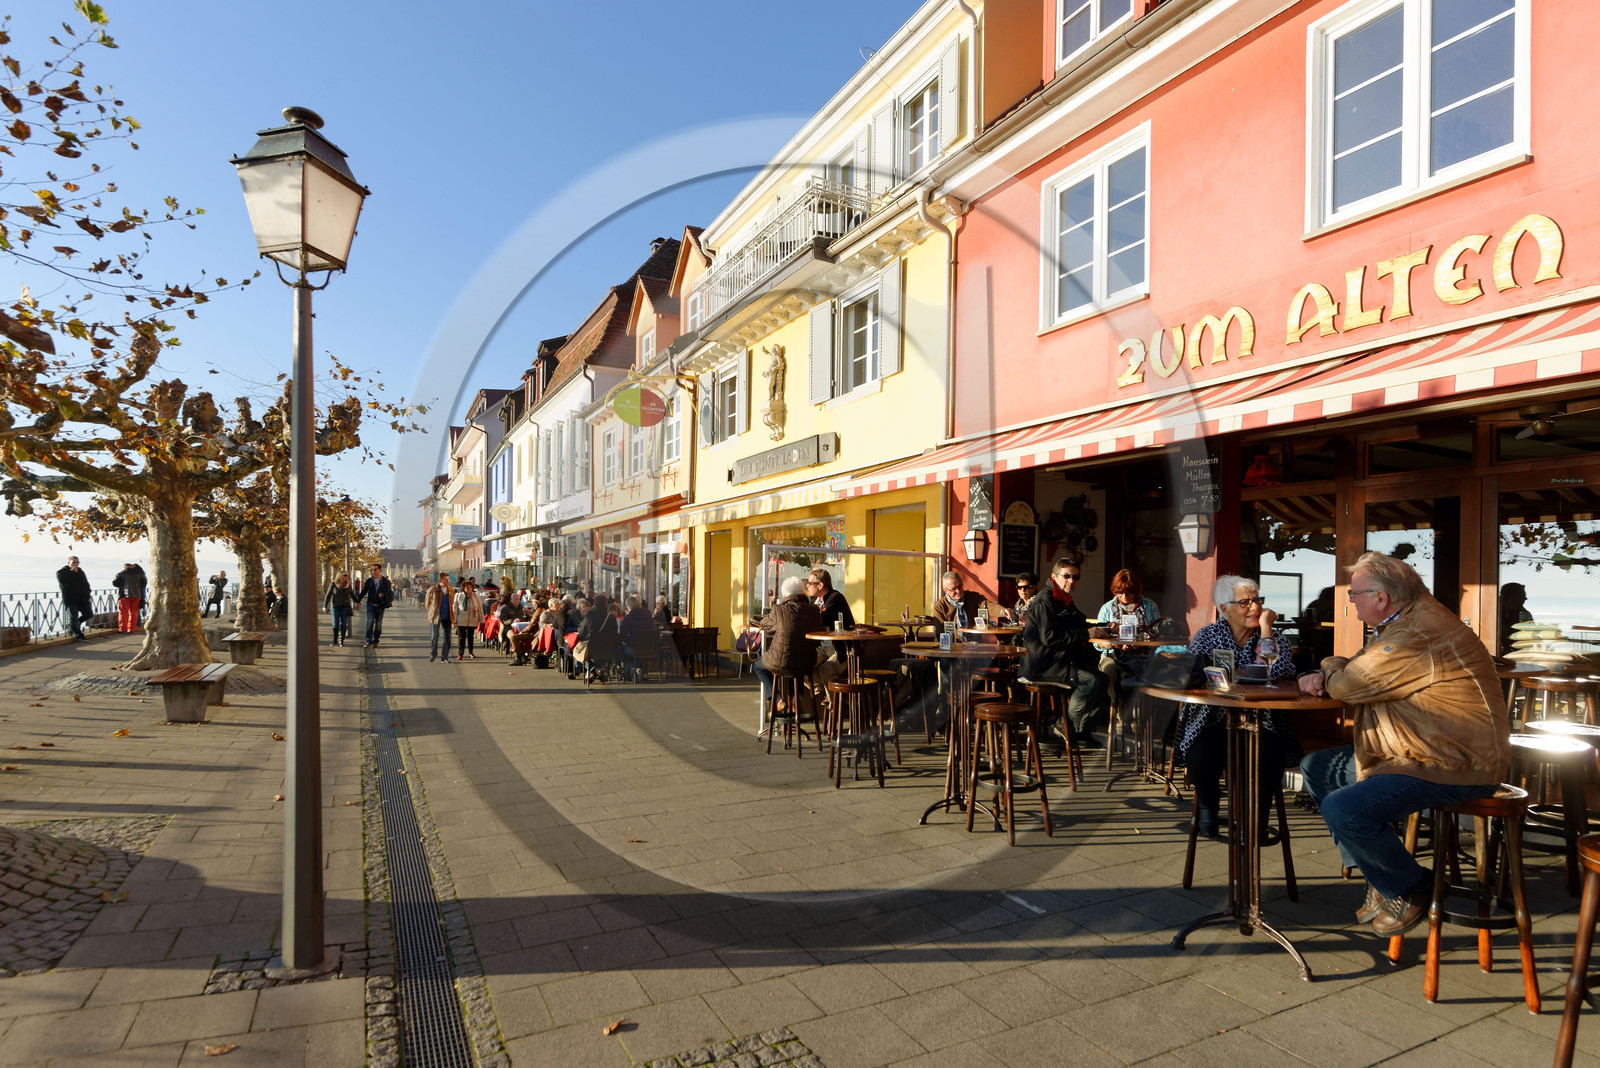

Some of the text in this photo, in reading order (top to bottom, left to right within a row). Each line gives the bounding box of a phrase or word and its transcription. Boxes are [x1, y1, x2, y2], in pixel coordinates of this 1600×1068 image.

[1117, 213, 1565, 389] ZUM ALTEN
[783, 446, 810, 465] LADEN
[1182, 454, 1219, 468] Hauswein
[1190, 483, 1219, 495] Thurgau
[827, 520, 844, 533] SALE
[603, 552, 618, 566] EIS
